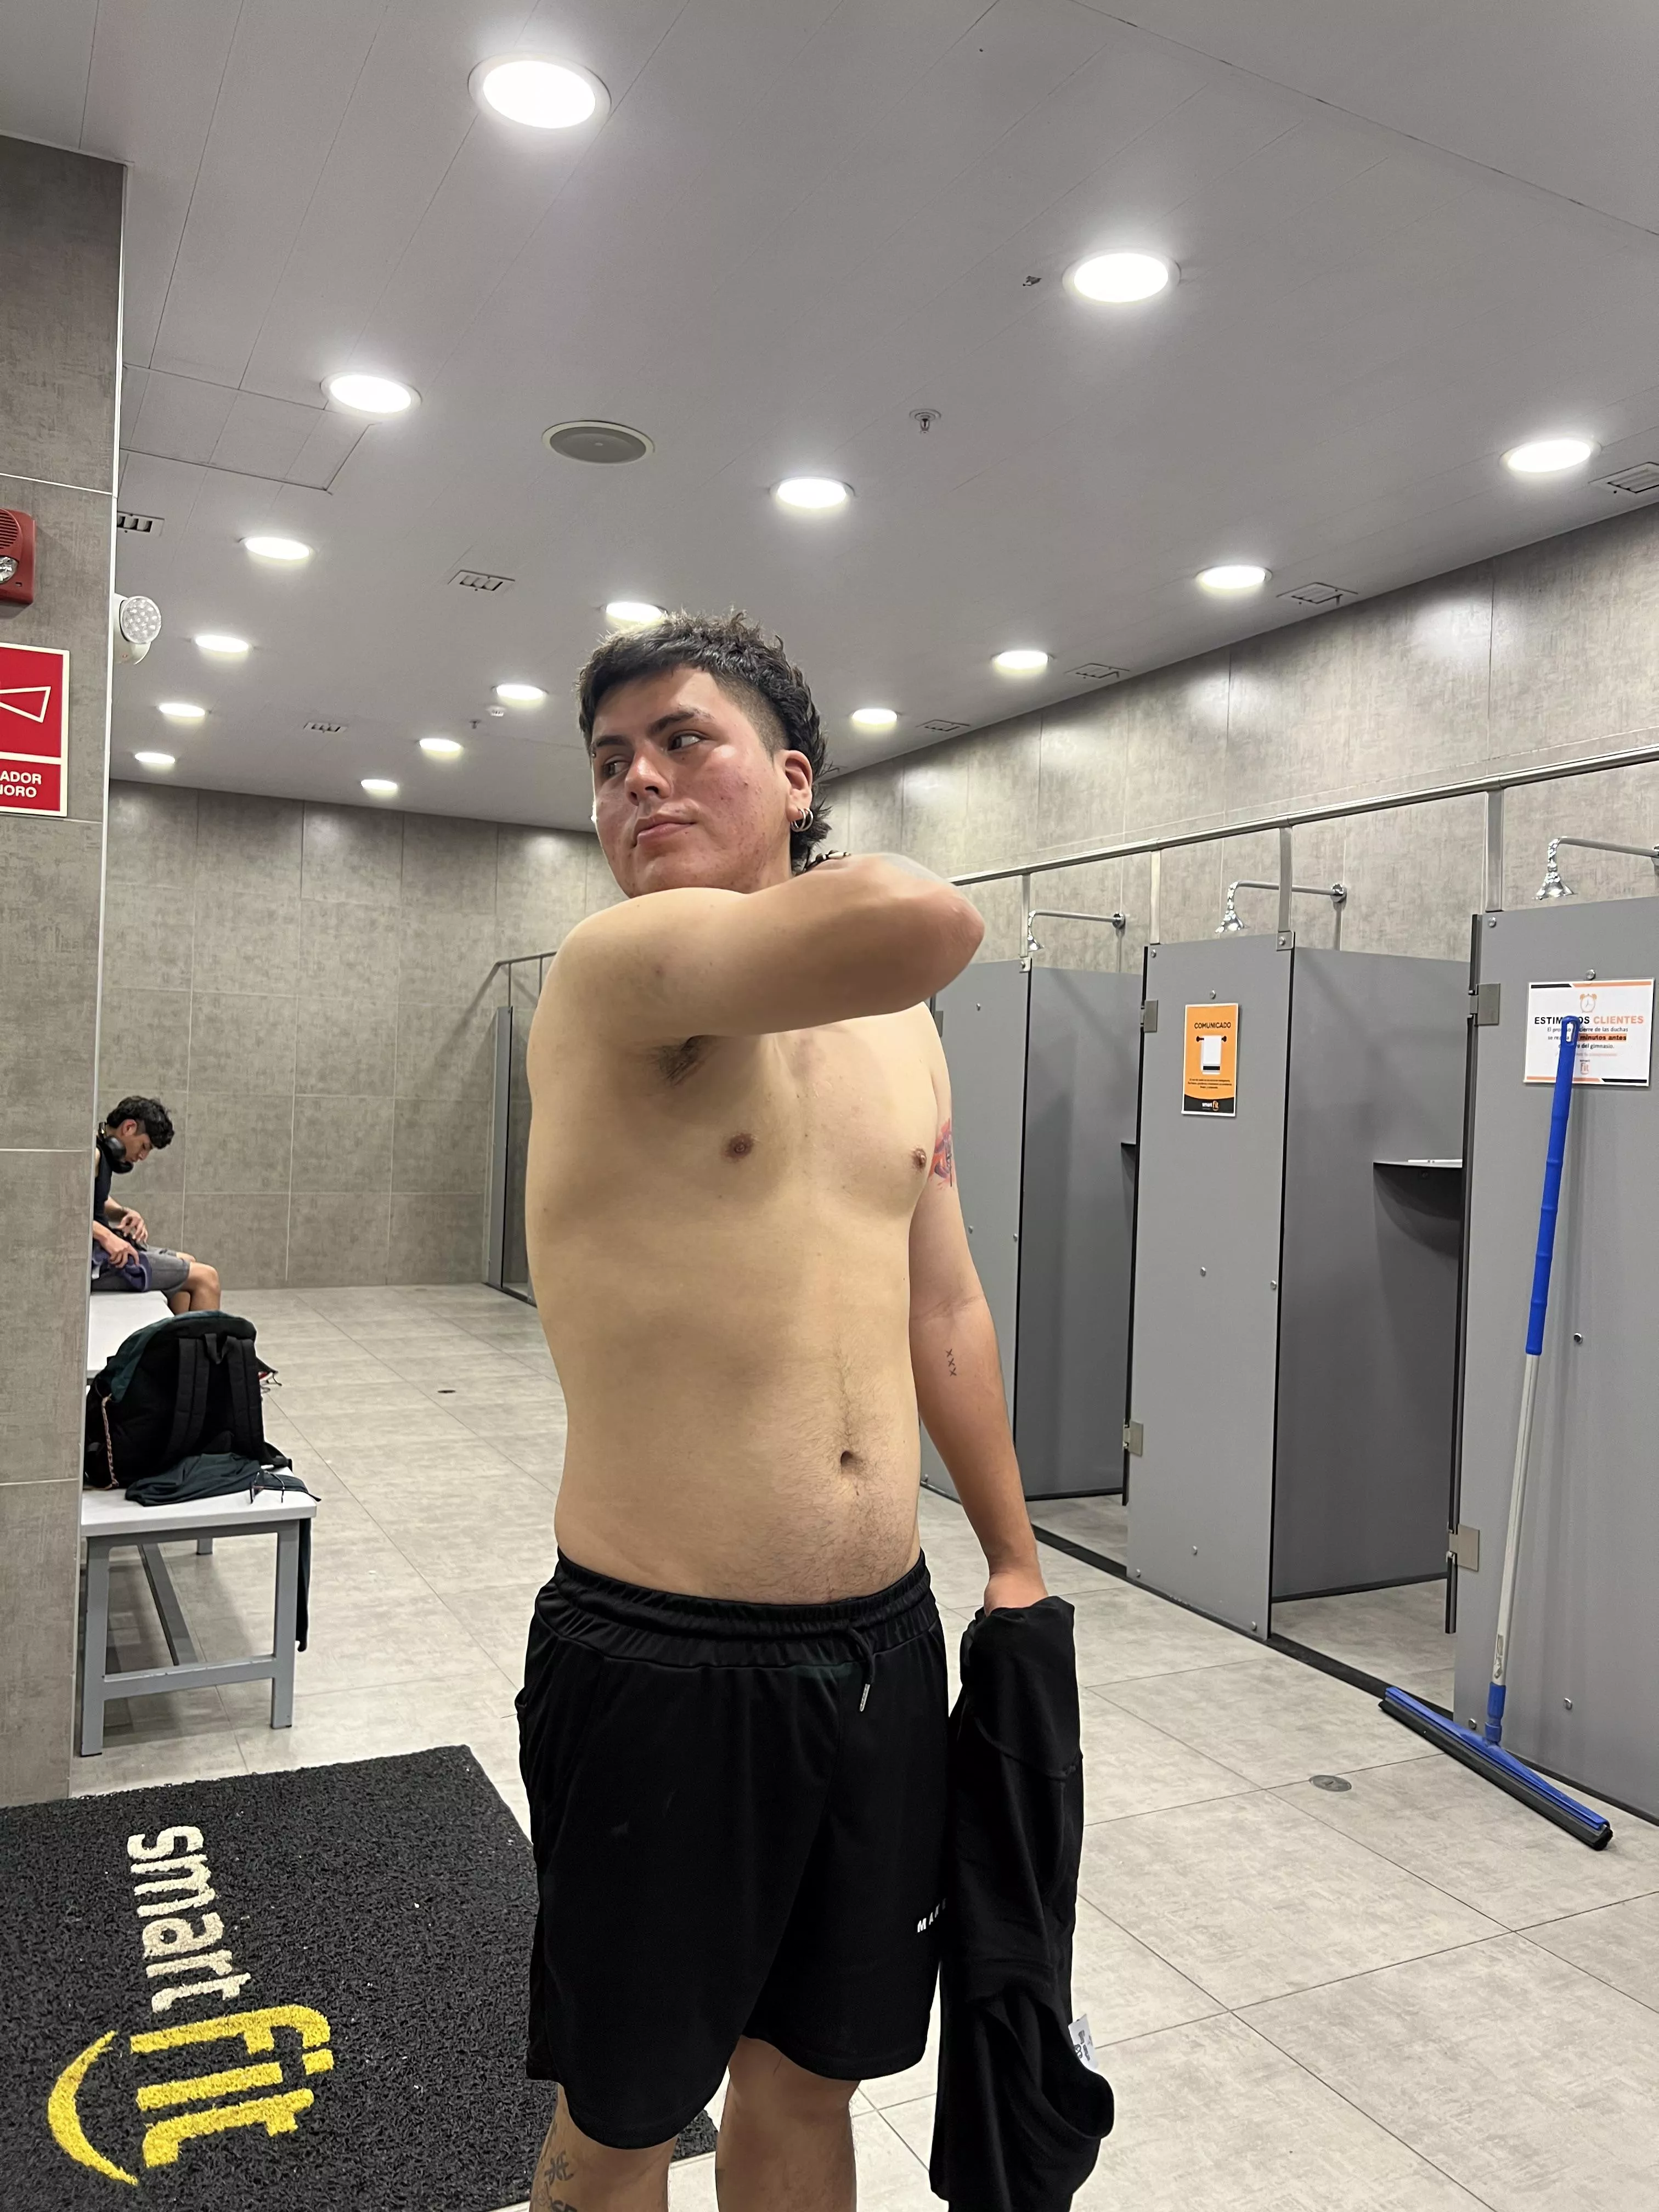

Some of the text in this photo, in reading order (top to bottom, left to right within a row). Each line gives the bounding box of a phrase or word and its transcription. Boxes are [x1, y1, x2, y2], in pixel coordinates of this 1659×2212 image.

[1534, 1015, 1644, 1024] ESTIMOS CLIENTES
[127, 1825, 251, 2013] smart
[129, 2004, 334, 2168] fit
